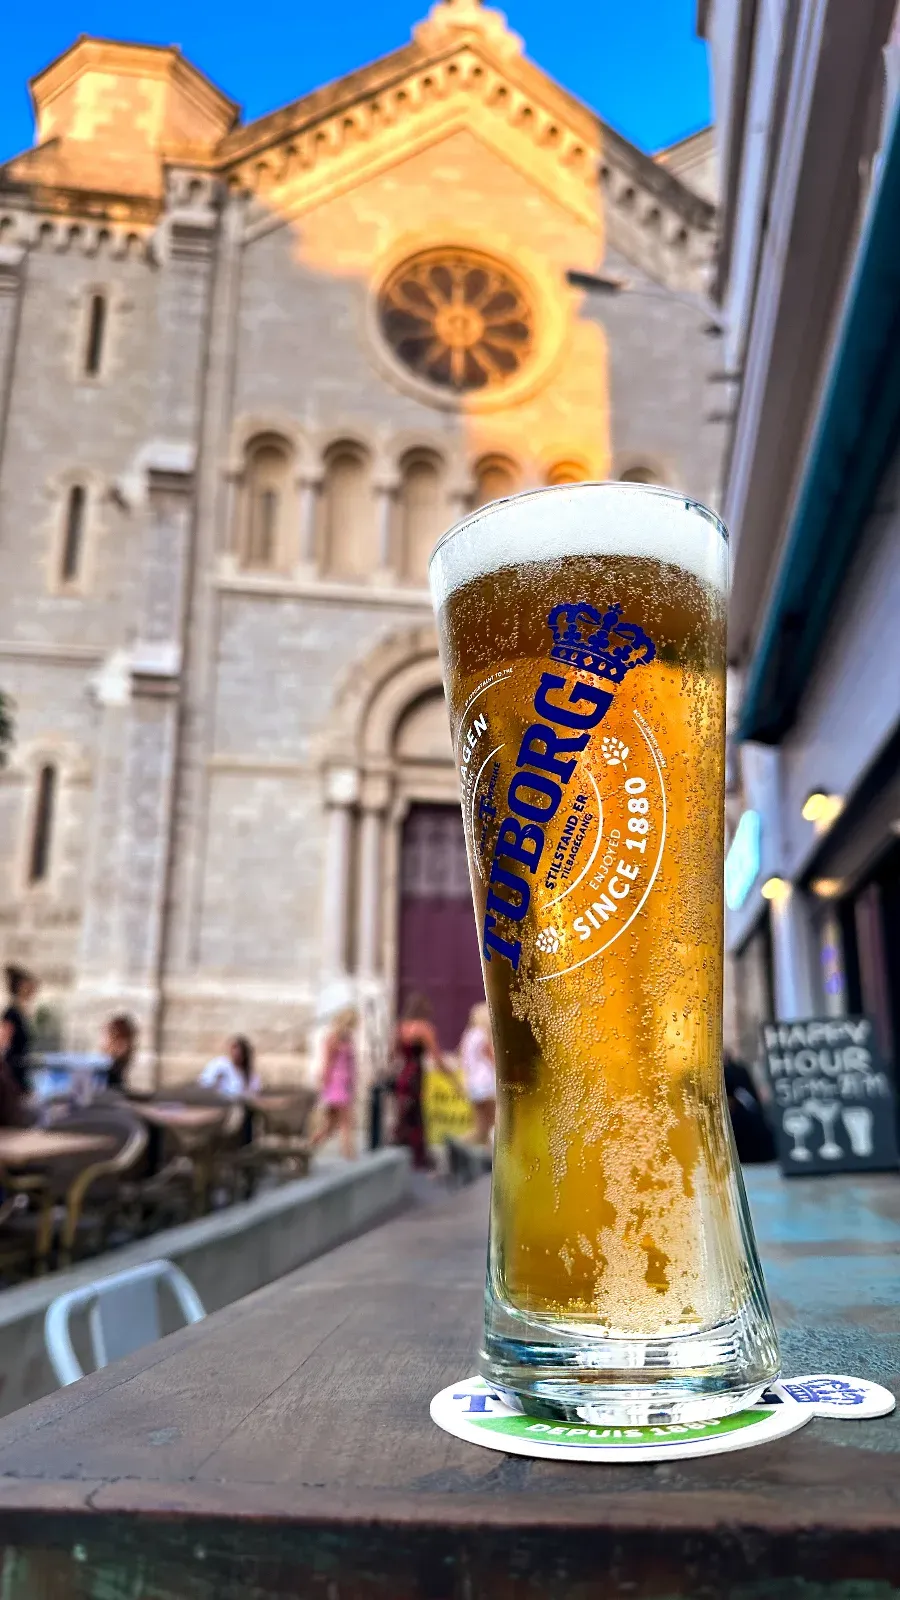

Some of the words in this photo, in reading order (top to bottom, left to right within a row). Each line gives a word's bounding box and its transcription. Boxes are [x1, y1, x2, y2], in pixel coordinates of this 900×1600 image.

[481, 672, 615, 971] TUBORG
[544, 814, 579, 891] STILSTAND
[572, 793, 589, 813] ER
[560, 812, 594, 880] TILBAGEGANG
[572, 858, 641, 941] SINCE
[624, 776, 649, 855] 1880
[589, 828, 621, 891] ENJOYED
[764, 1019, 871, 1049] HAPPY
[768, 1046, 875, 1078] HOUR
[524, 1423, 644, 1439] DEPUIS
